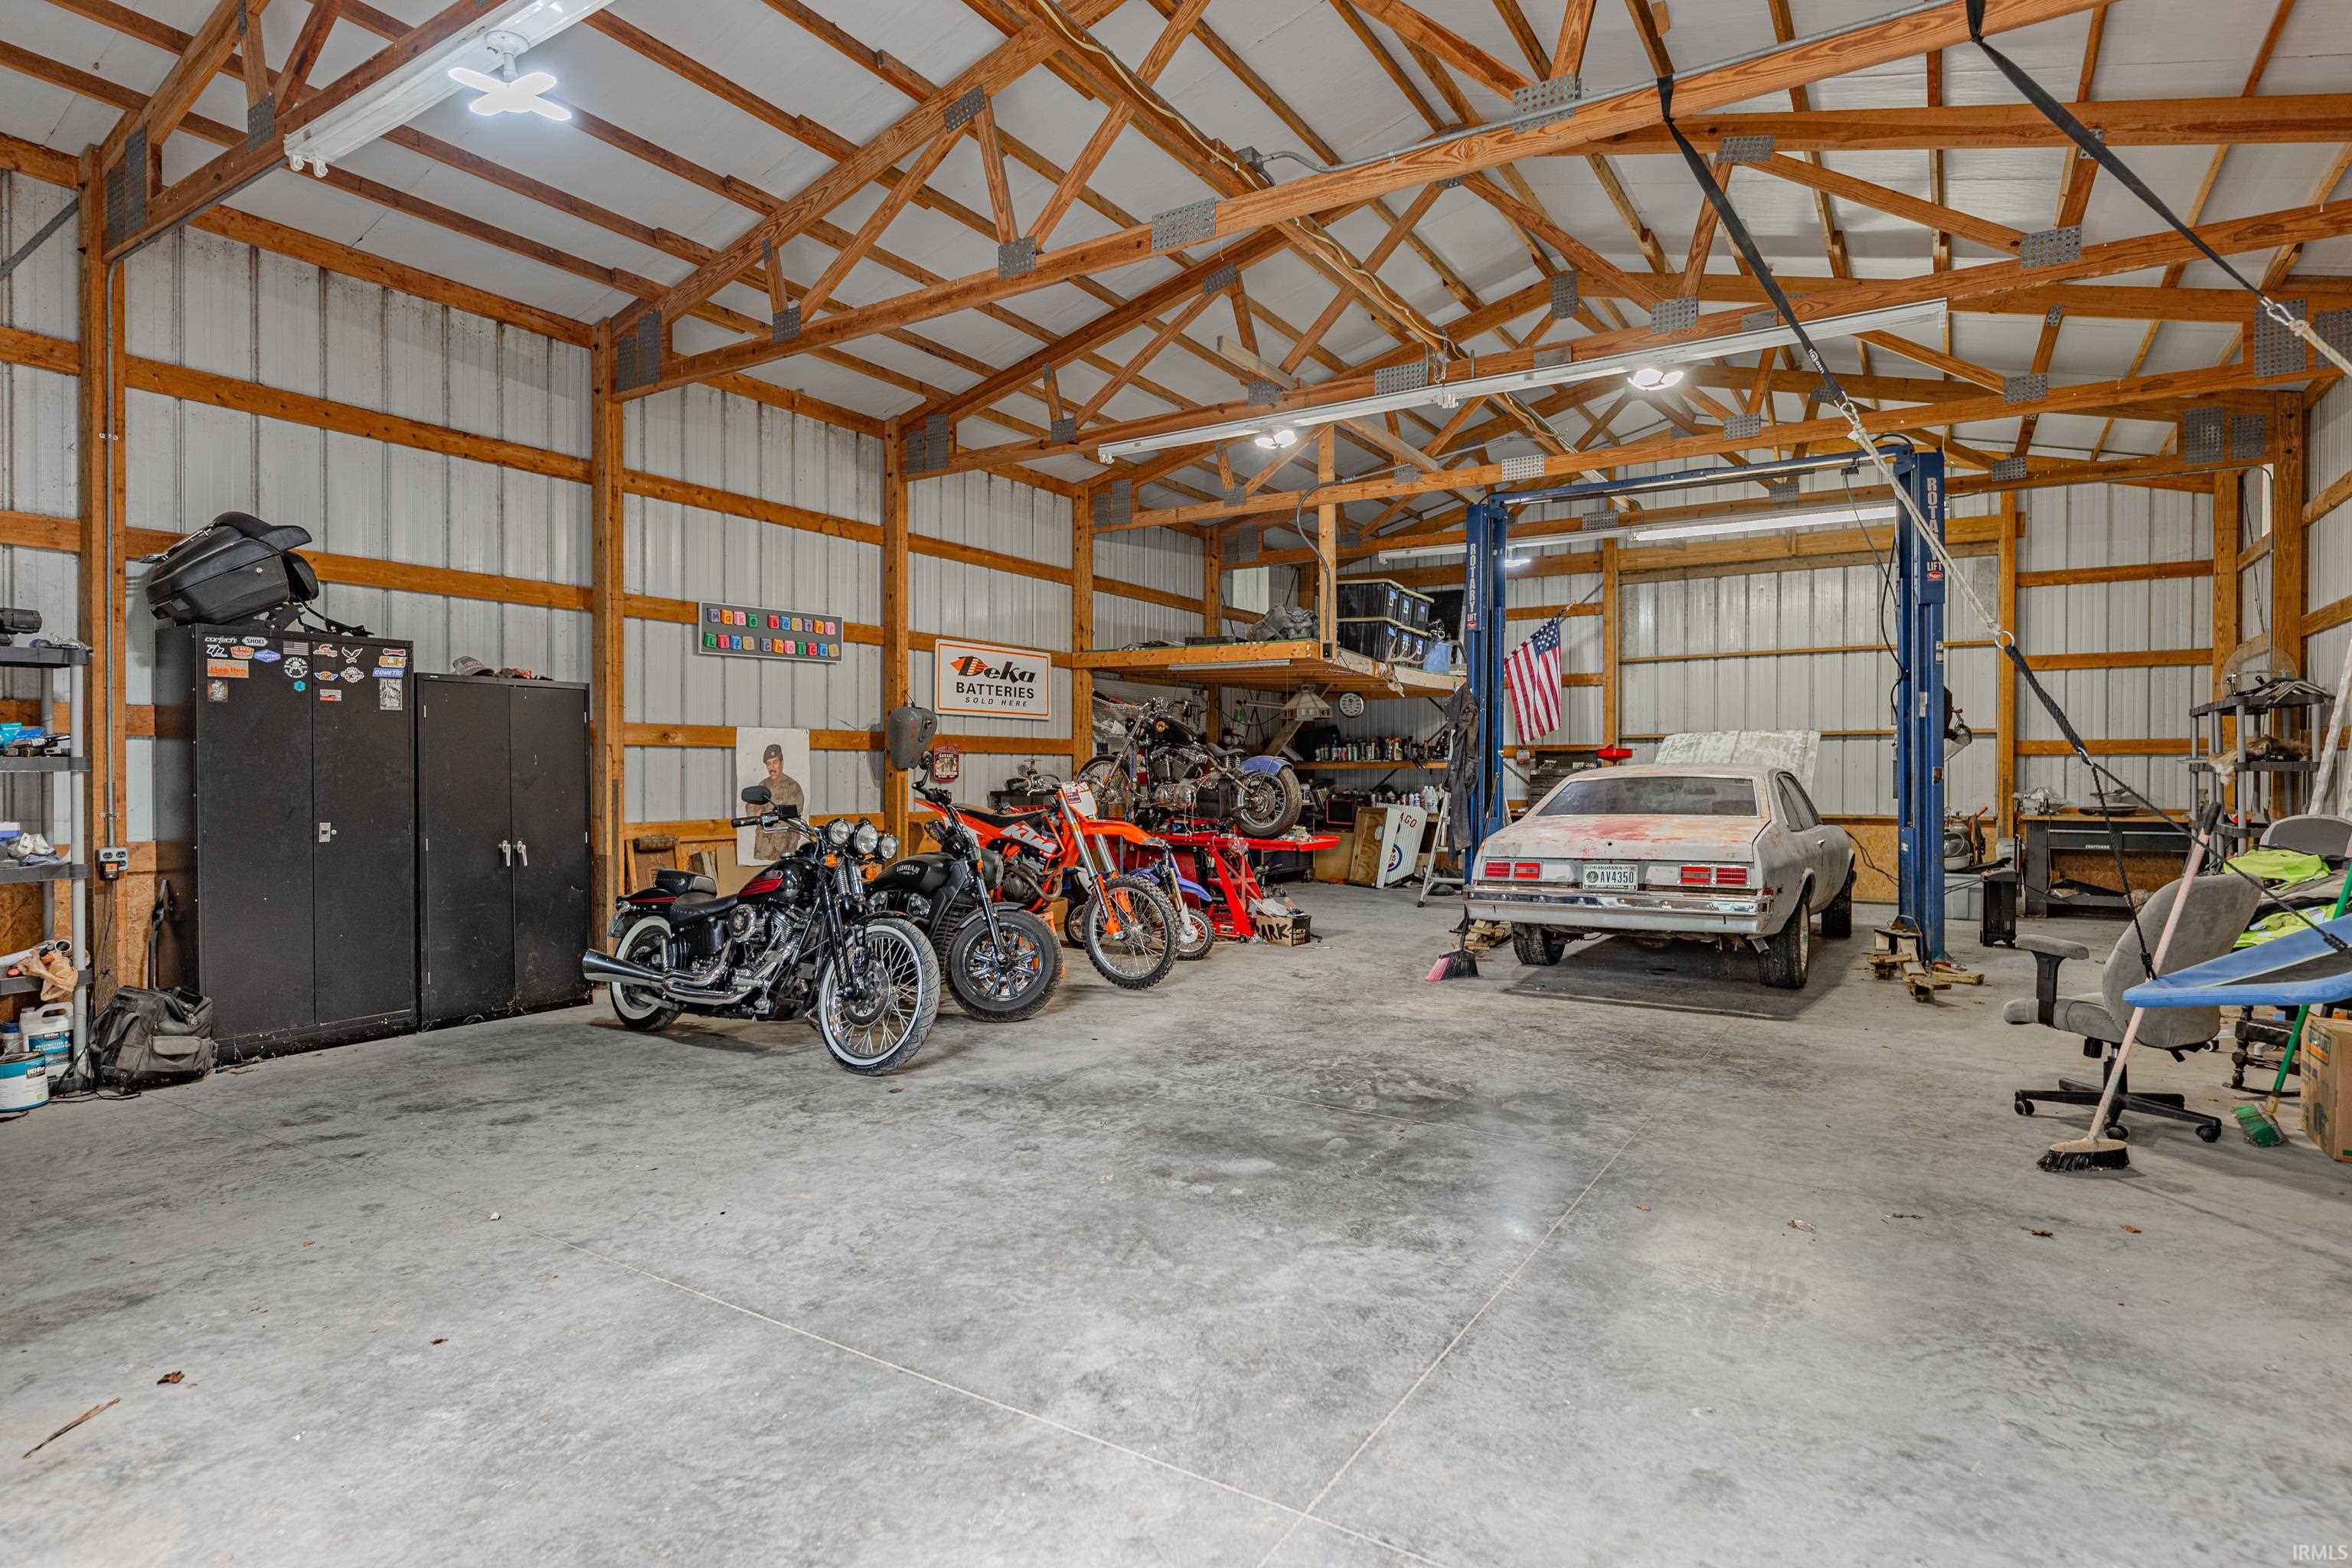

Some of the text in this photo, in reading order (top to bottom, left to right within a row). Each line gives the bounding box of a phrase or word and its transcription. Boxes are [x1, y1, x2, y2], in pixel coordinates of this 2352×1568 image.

[1926, 561, 1942, 571] LIFT
[707, 608, 759, 628] Make
[1467, 612, 1477, 622] LIFT
[949, 655, 1036, 684] Deka
[956, 681, 1034, 699] BATTERIES
[965, 697, 1027, 707] SOLD HERE
[1000, 824, 1057, 853] KTM
[1600, 871, 1634, 884] AV4350
